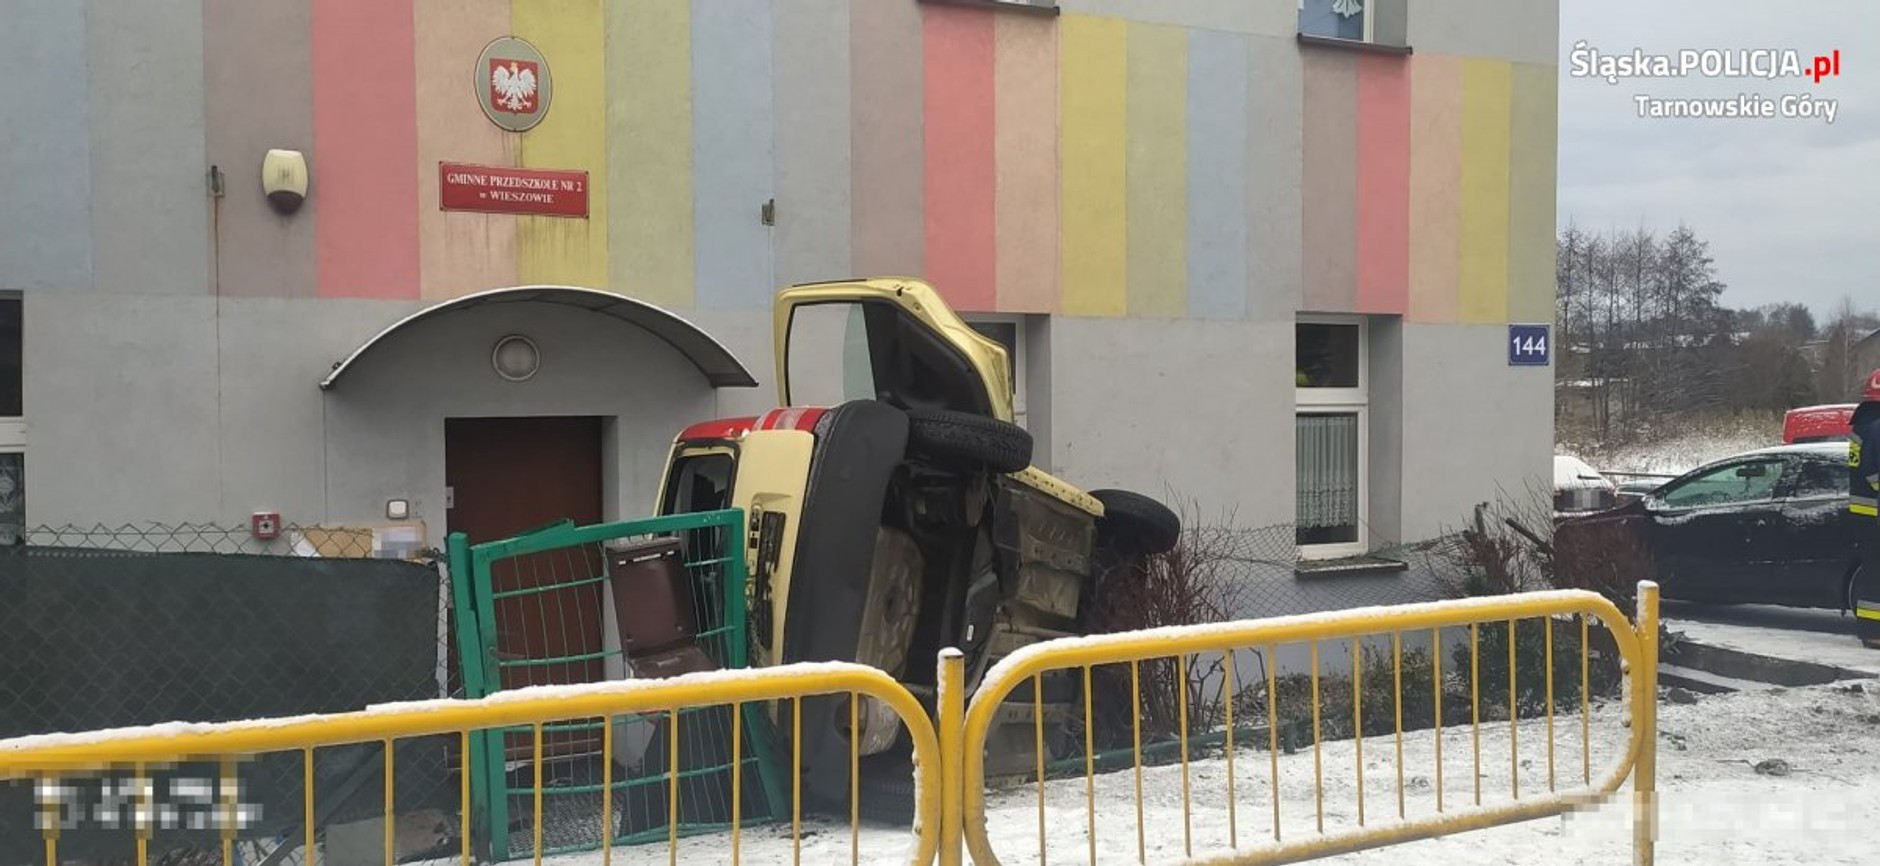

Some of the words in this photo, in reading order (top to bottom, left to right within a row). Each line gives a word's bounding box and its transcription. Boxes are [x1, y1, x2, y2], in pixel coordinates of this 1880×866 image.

[447, 173, 487, 186] GMINNE
[489, 175, 559, 191] PRZEDSZKOLE
[560, 179, 574, 191] NR
[576, 181, 583, 192] 2
[489, 191, 554, 204] WIESZOWIE
[1513, 336, 1546, 356] 144
